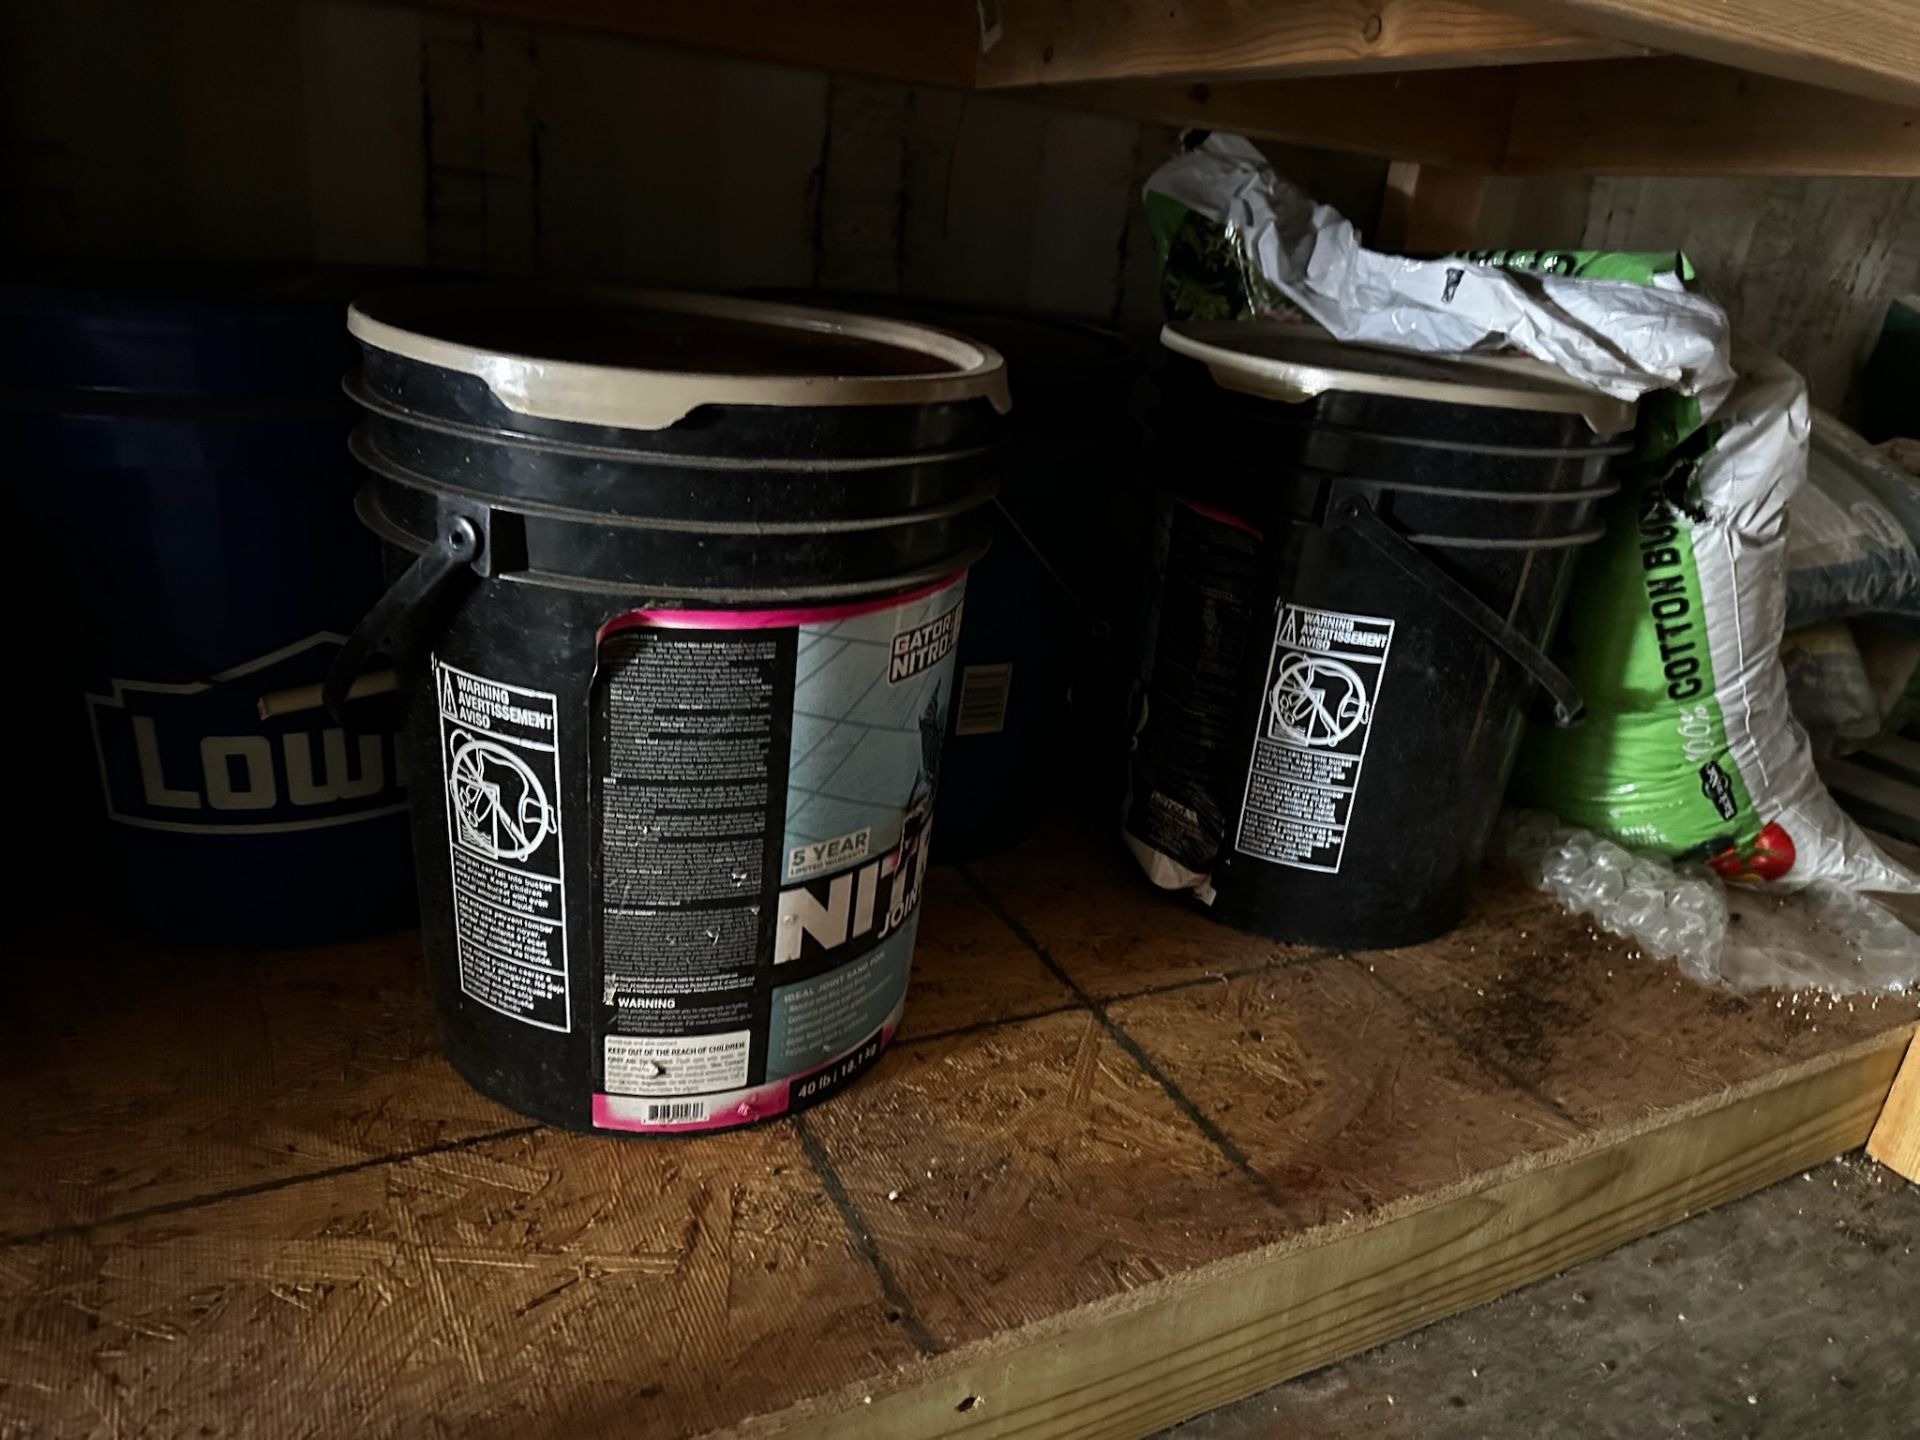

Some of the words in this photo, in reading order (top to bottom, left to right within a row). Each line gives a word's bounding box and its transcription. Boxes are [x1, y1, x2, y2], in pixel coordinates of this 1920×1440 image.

[894, 610, 953, 659] GATOR
[1303, 611, 1355, 633] WARNING
[1299, 634, 1331, 651] AVISO
[1300, 623, 1388, 649] AVERTISSEMENT
[1645, 574, 1703, 701] COTTON
[891, 633, 951, 683] NITRO
[456, 674, 510, 706] WARNING
[458, 690, 554, 731] AVERTISSEMENT
[459, 705, 491, 730] AVISO
[791, 849, 806, 867] 5
[813, 831, 868, 862] YEAR
[489, 875, 508, 889] Keep
[509, 882, 541, 897] children
[524, 920, 553, 934] tomber
[618, 997, 676, 1009] WARNING
[798, 1079, 816, 1099] 40
[818, 1072, 831, 1090] lb
